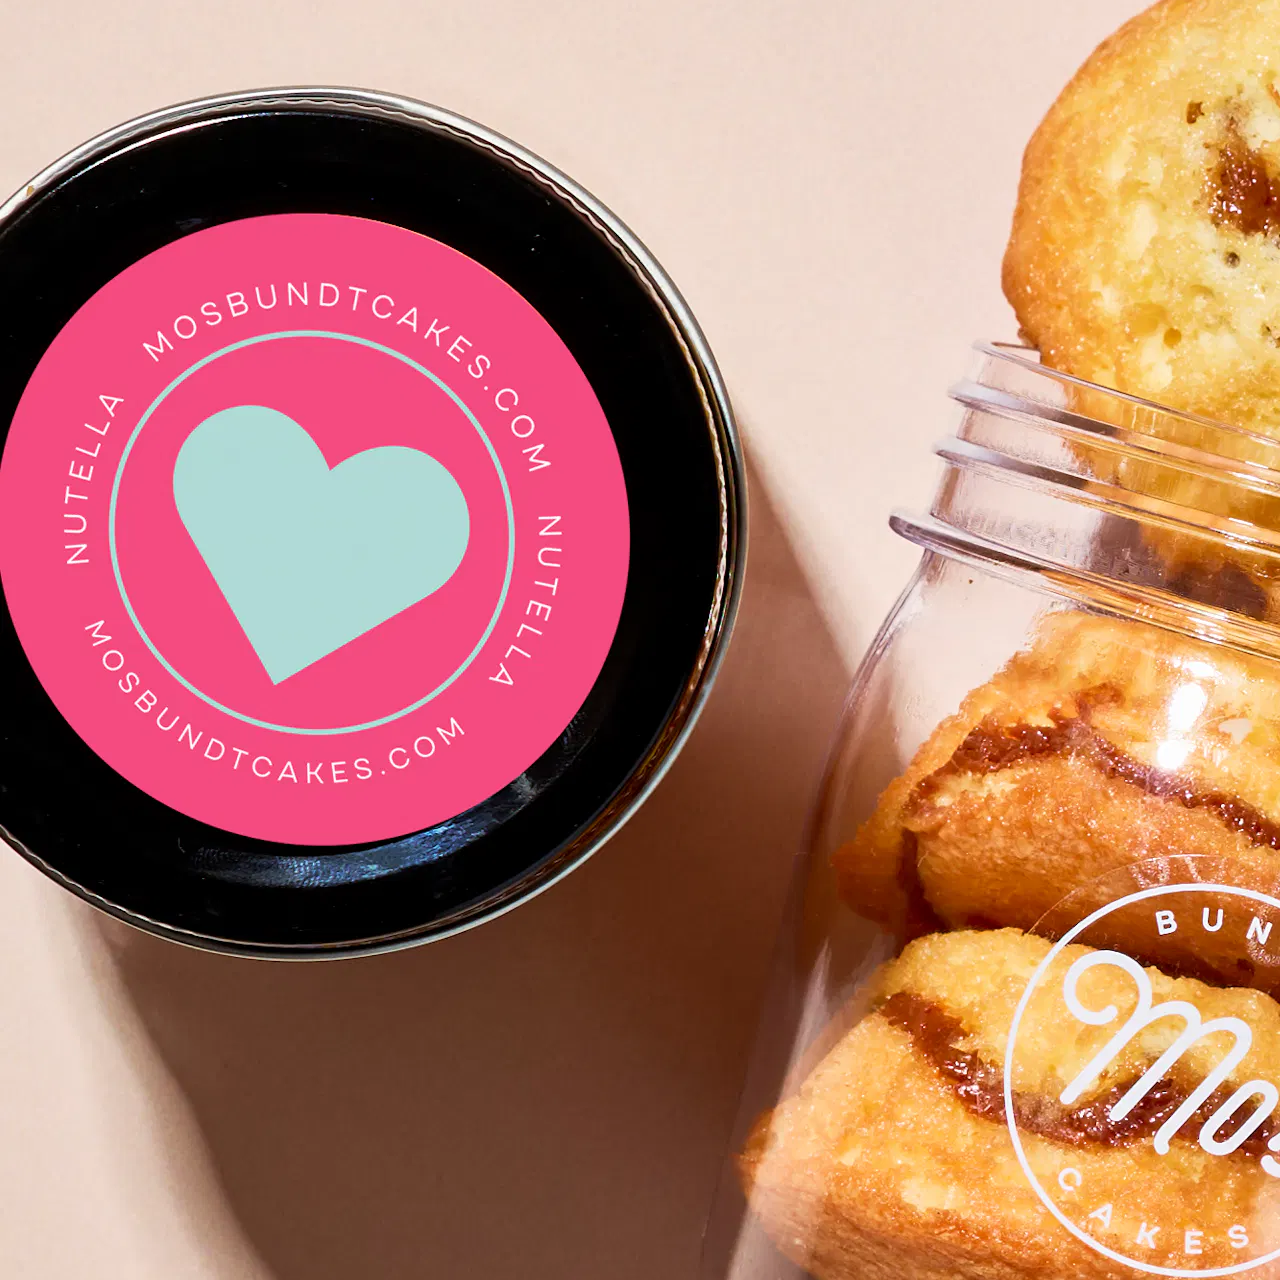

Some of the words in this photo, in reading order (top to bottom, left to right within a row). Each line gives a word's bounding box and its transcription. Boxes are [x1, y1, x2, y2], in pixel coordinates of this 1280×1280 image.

[141, 280, 553, 473] MOSBUNDTCAKES.COM
[62, 393, 126, 566] NUTELLA
[487, 514, 564, 687] NUTELLA
[83, 618, 466, 785] MOSBUNDTCAKES.COM
[1057, 1166, 1250, 1256] CAKES
